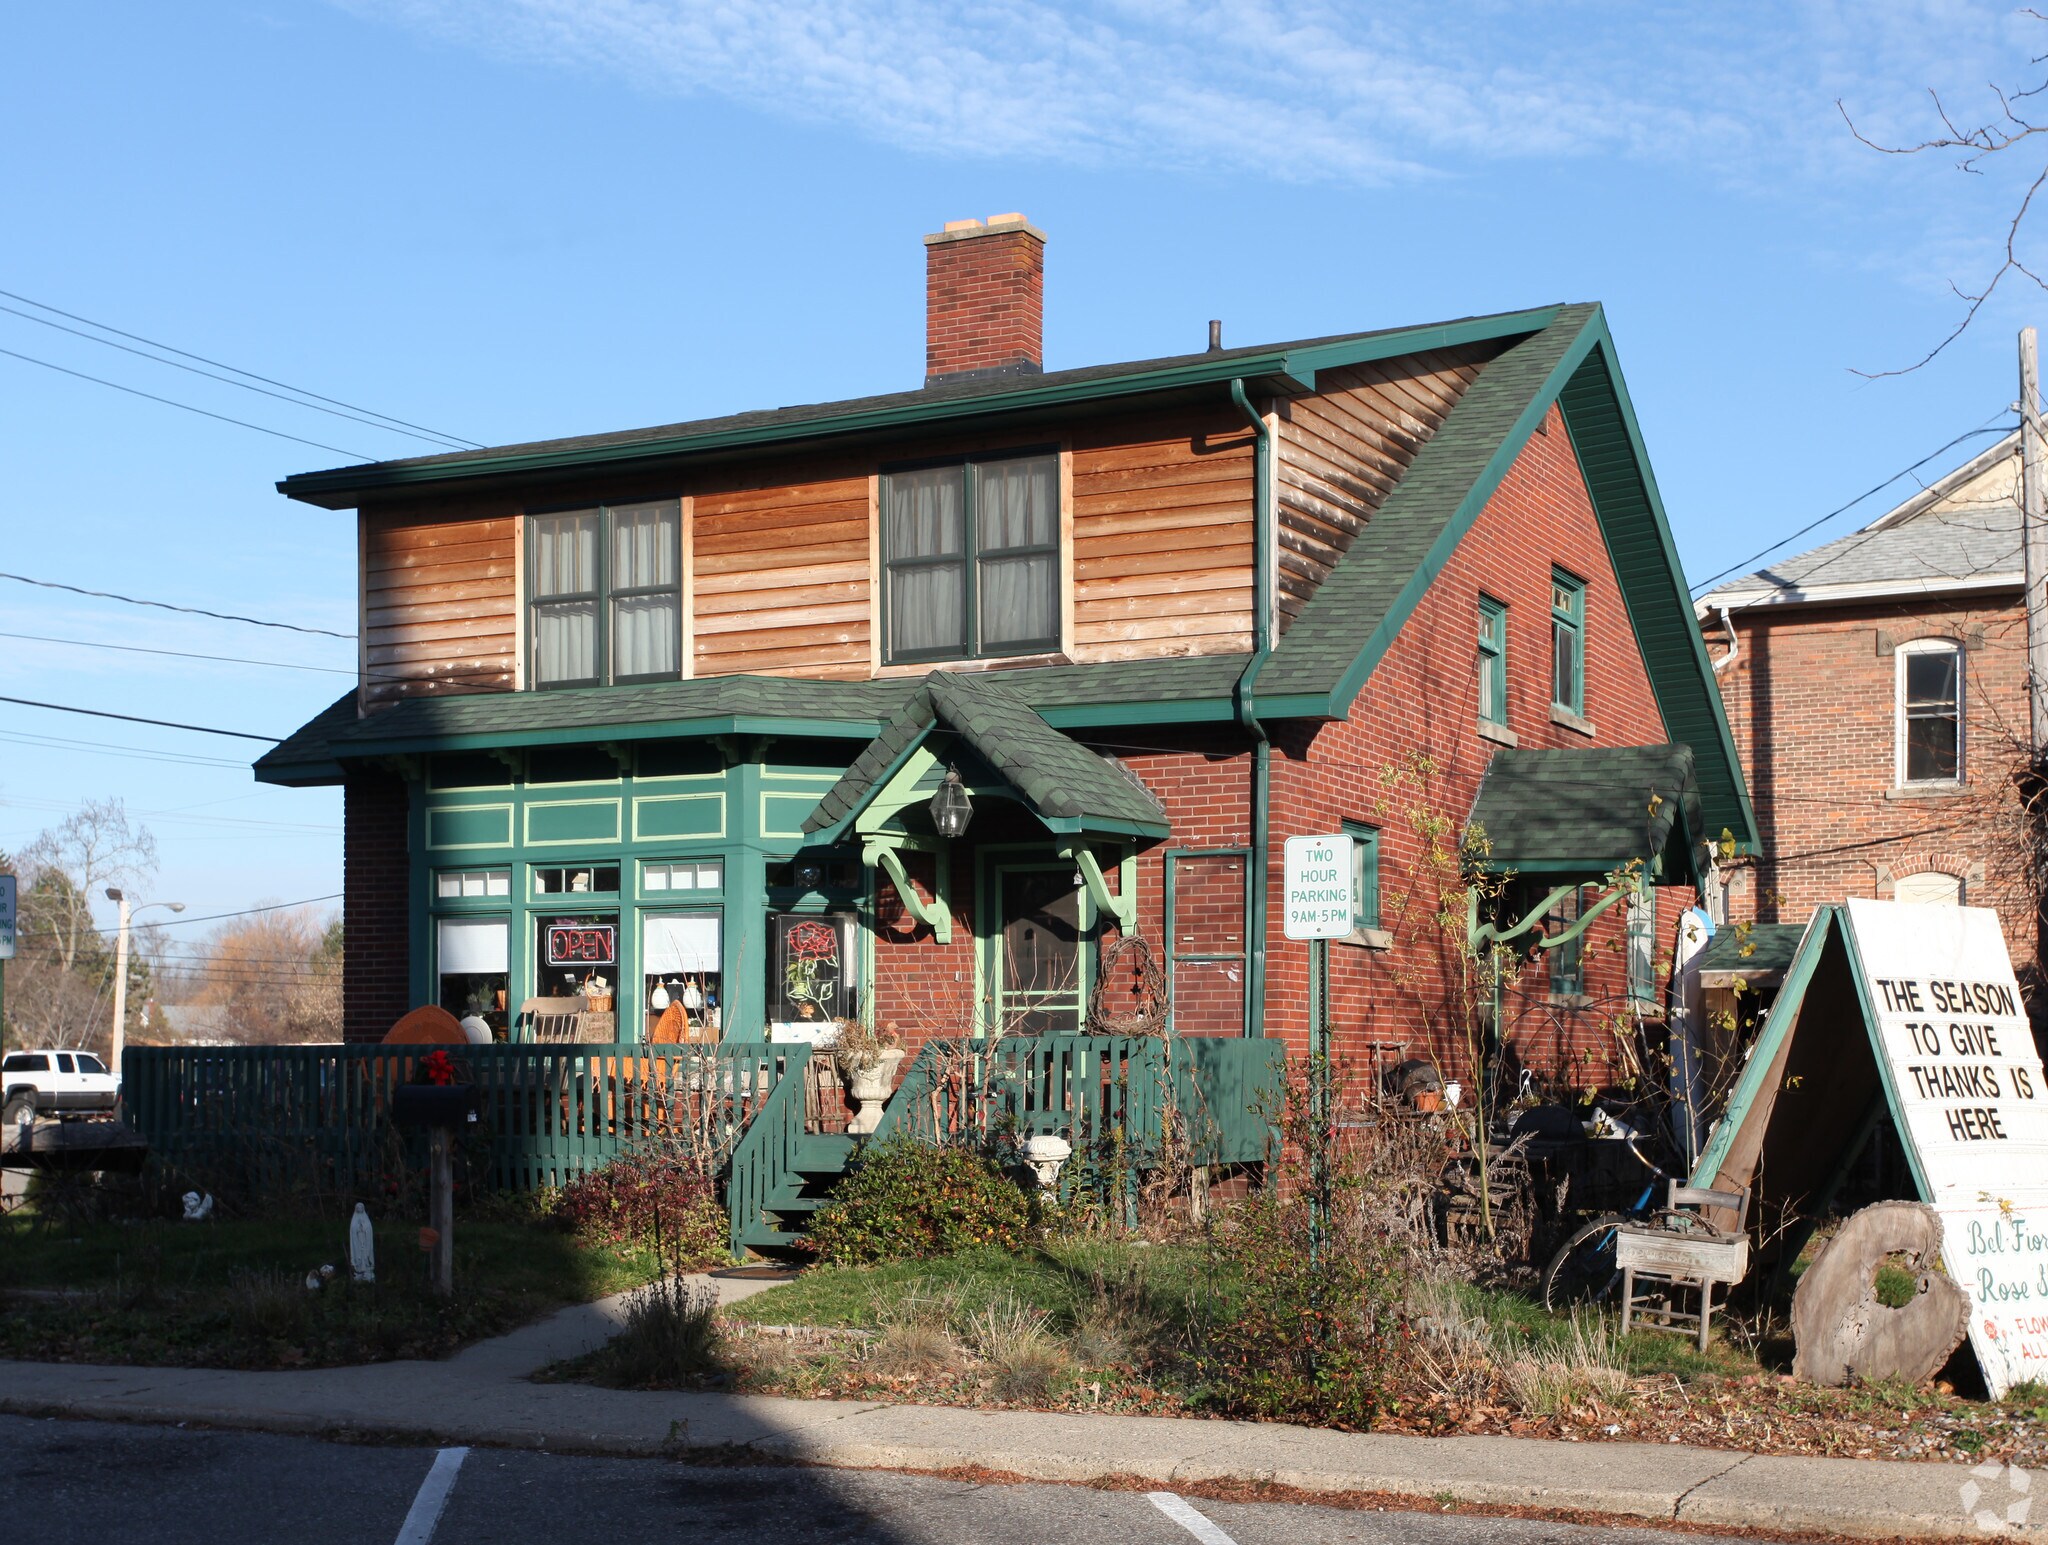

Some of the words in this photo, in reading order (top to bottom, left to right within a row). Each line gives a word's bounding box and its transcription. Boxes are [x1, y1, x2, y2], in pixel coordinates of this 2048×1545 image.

[1306, 849, 1333, 862] TWO
[1301, 869, 1337, 882] HOUR
[1291, 889, 1347, 903] PARKING
[552, 930, 611, 959] OPEN
[1876, 979, 1924, 1012] THE
[1930, 980, 2017, 1016] SEASON
[1905, 1023, 1941, 1056] TO
[1949, 1023, 2002, 1056] GIVE
[1908, 1065, 2001, 1099] THANKS
[2010, 1067, 2034, 1099] IS
[1945, 1108, 2008, 1141] HERE
[1967, 1219, 2005, 1255] Bel
[1977, 1267, 2029, 1303] Rose
[2021, 1342, 2048, 1360] ALL
